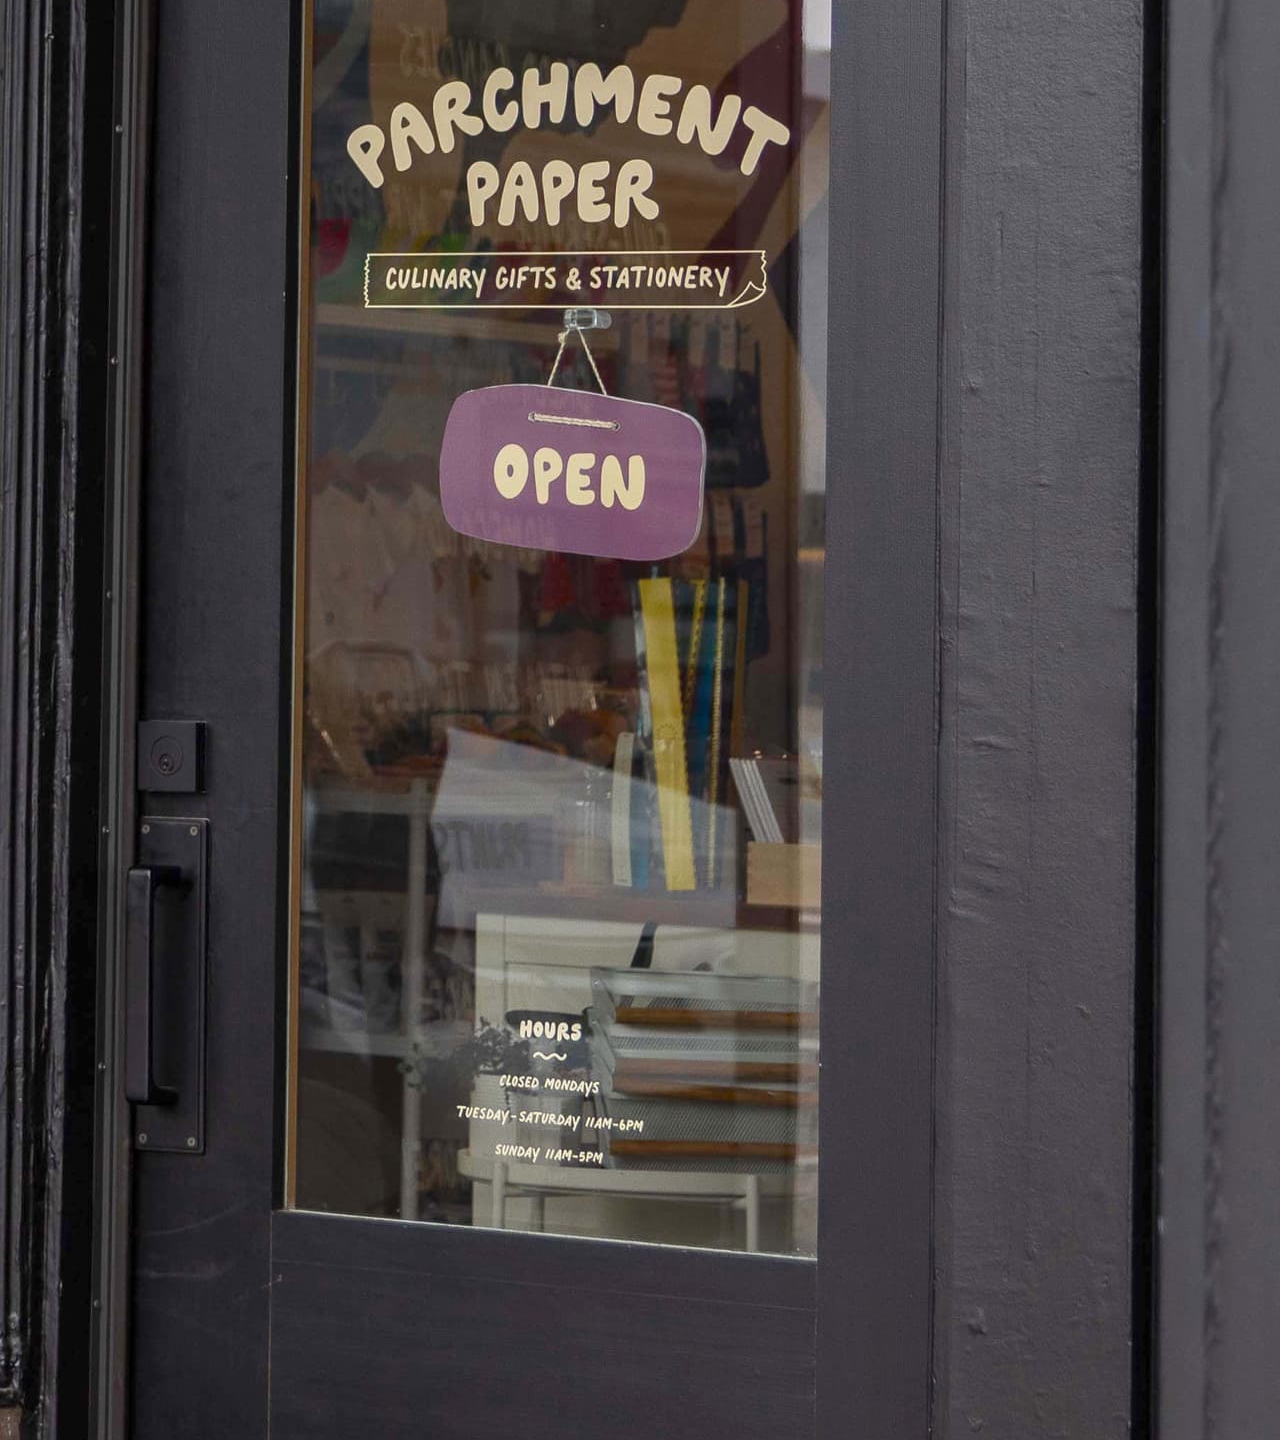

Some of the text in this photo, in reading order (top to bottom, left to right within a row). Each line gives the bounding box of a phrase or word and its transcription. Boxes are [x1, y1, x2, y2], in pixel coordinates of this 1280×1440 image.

[347, 62, 790, 189] PARCHMENT
[467, 160, 659, 227] PAPER
[386, 266, 729, 297] CULINARY GIFTS & STATIONERY
[494, 444, 645, 510] OPEN
[519, 1019, 582, 1042] HOURS
[499, 1074, 600, 1097] CLOSED MONDAYS
[585, 1116, 644, 1133] 11AM-6PM
[495, 1144, 604, 1164] SUNDAY 11AM-5PM
